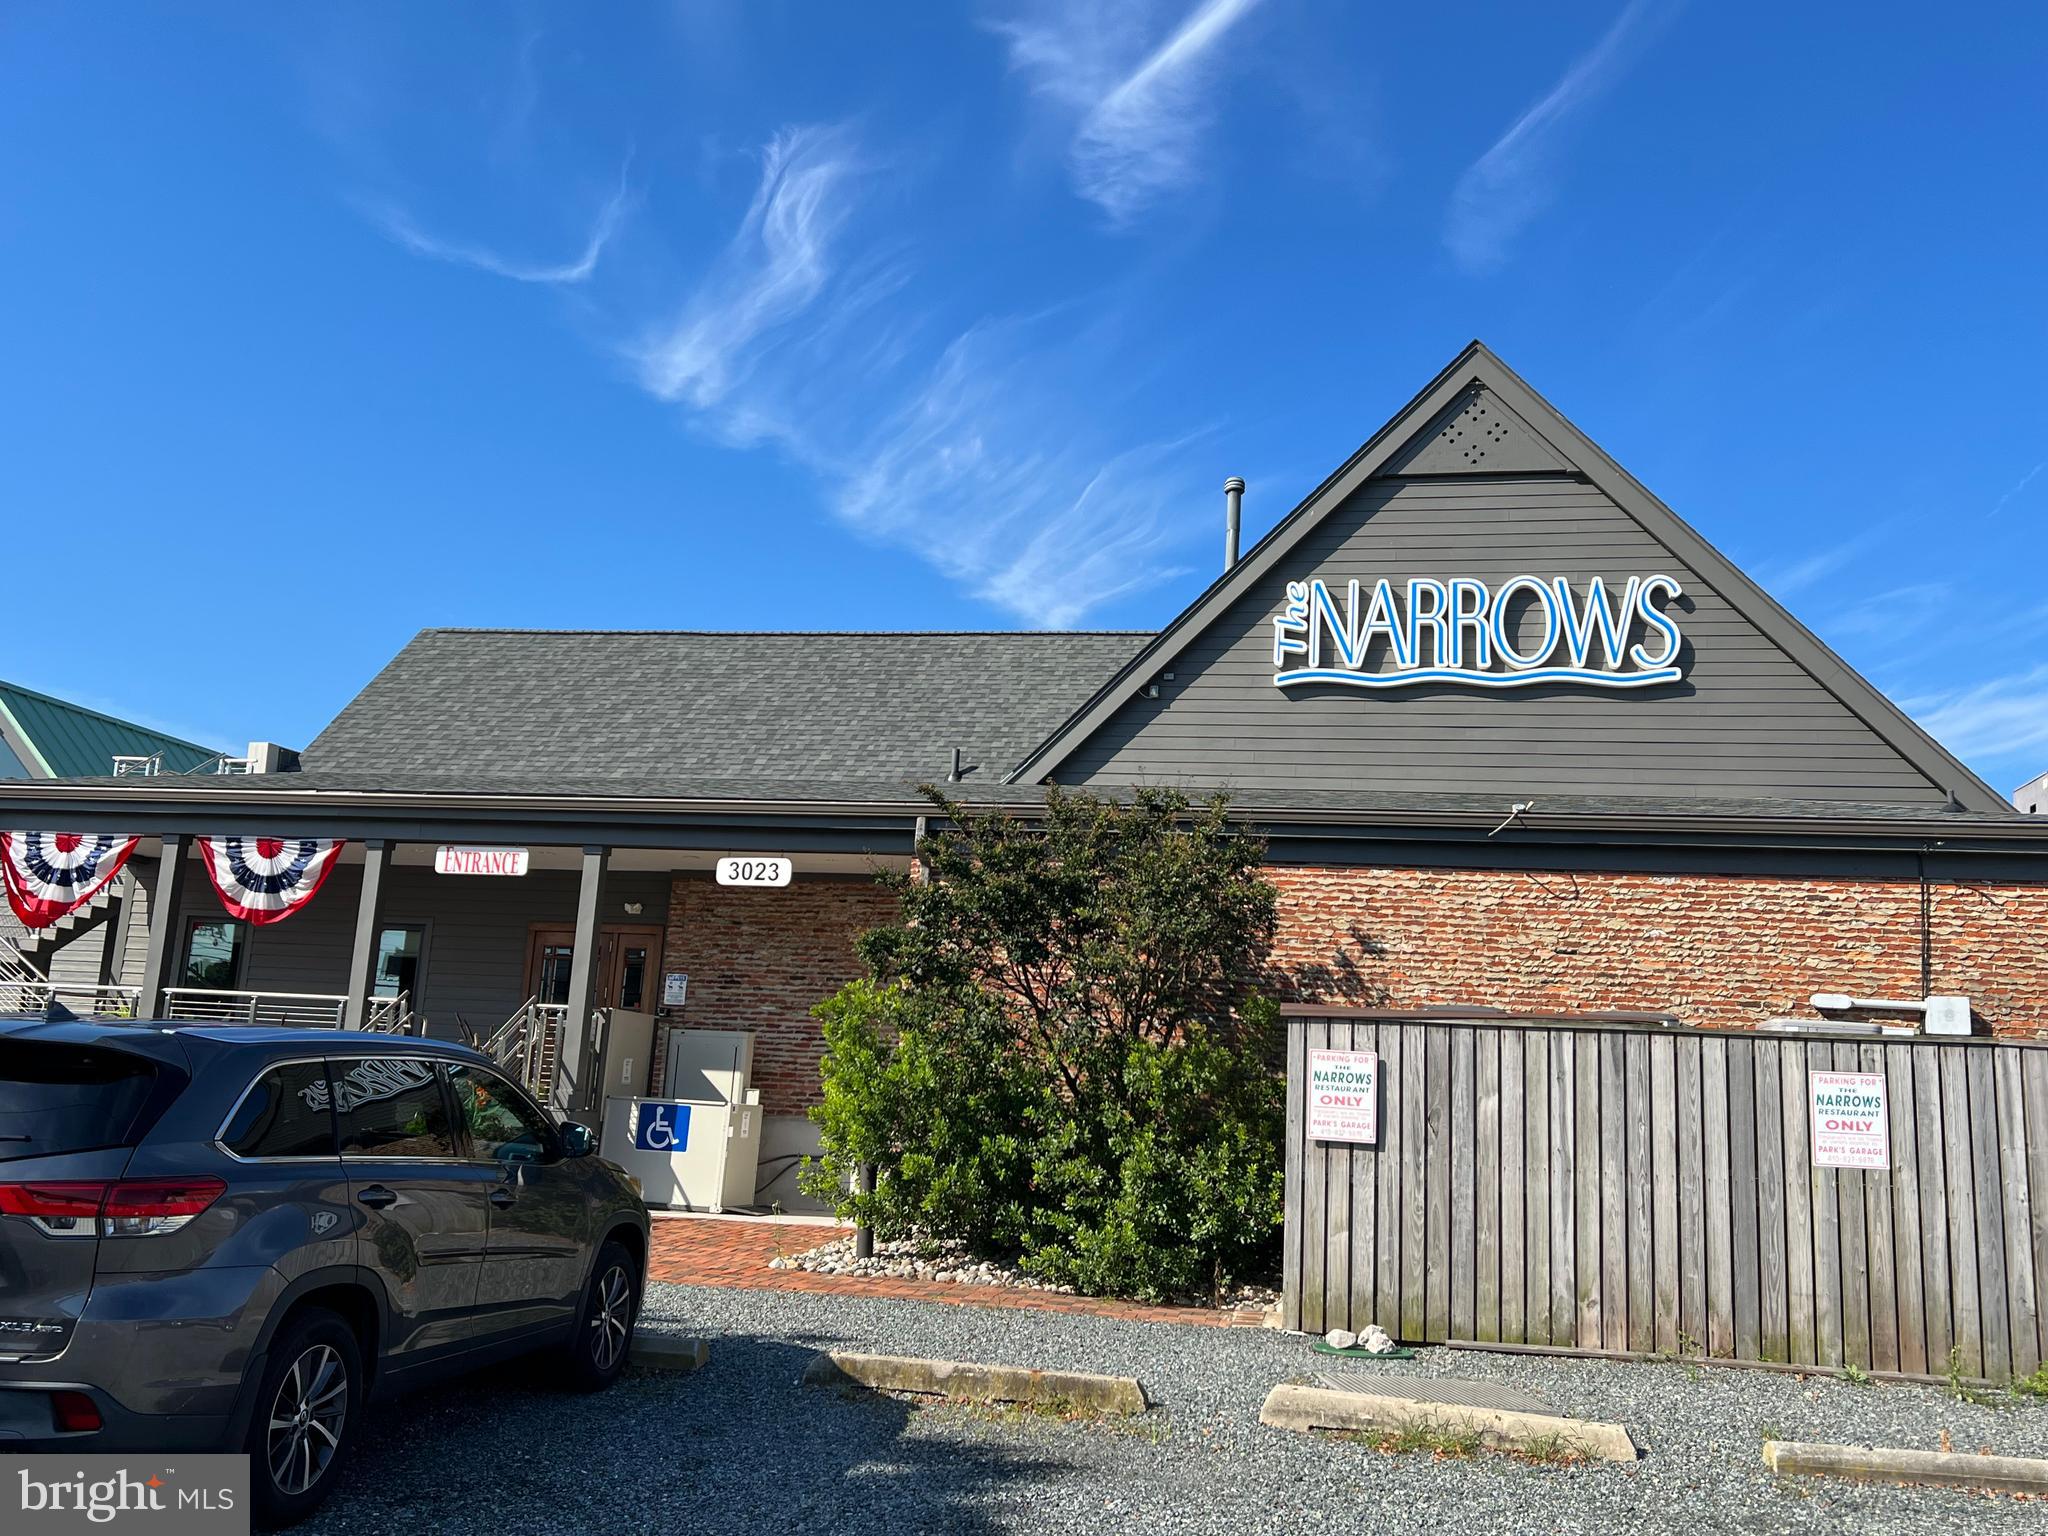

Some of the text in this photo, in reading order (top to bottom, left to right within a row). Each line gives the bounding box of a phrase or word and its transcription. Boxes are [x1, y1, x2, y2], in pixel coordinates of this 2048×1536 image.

[1273, 574, 1683, 669] The NARROWS
[443, 846, 521, 875] ENTRANCE
[728, 861, 779, 881] 3023
[1317, 1054, 1369, 1063] PARKING FOR
[1313, 1070, 1372, 1085] NARROWS
[1818, 1076, 1876, 1086] PARKING FOR
[1315, 1084, 1370, 1093] RESTAURANT
[1320, 1095, 1362, 1106] ONLY
[1816, 1094, 1881, 1108] NARROWS
[1818, 1108, 1880, 1117] RESTAURANT
[1313, 1119, 1371, 1130] PARK'S GARAGE
[1825, 1119, 1873, 1132] ONLY
[1818, 1146, 1883, 1156] PARK'S GARAGE
